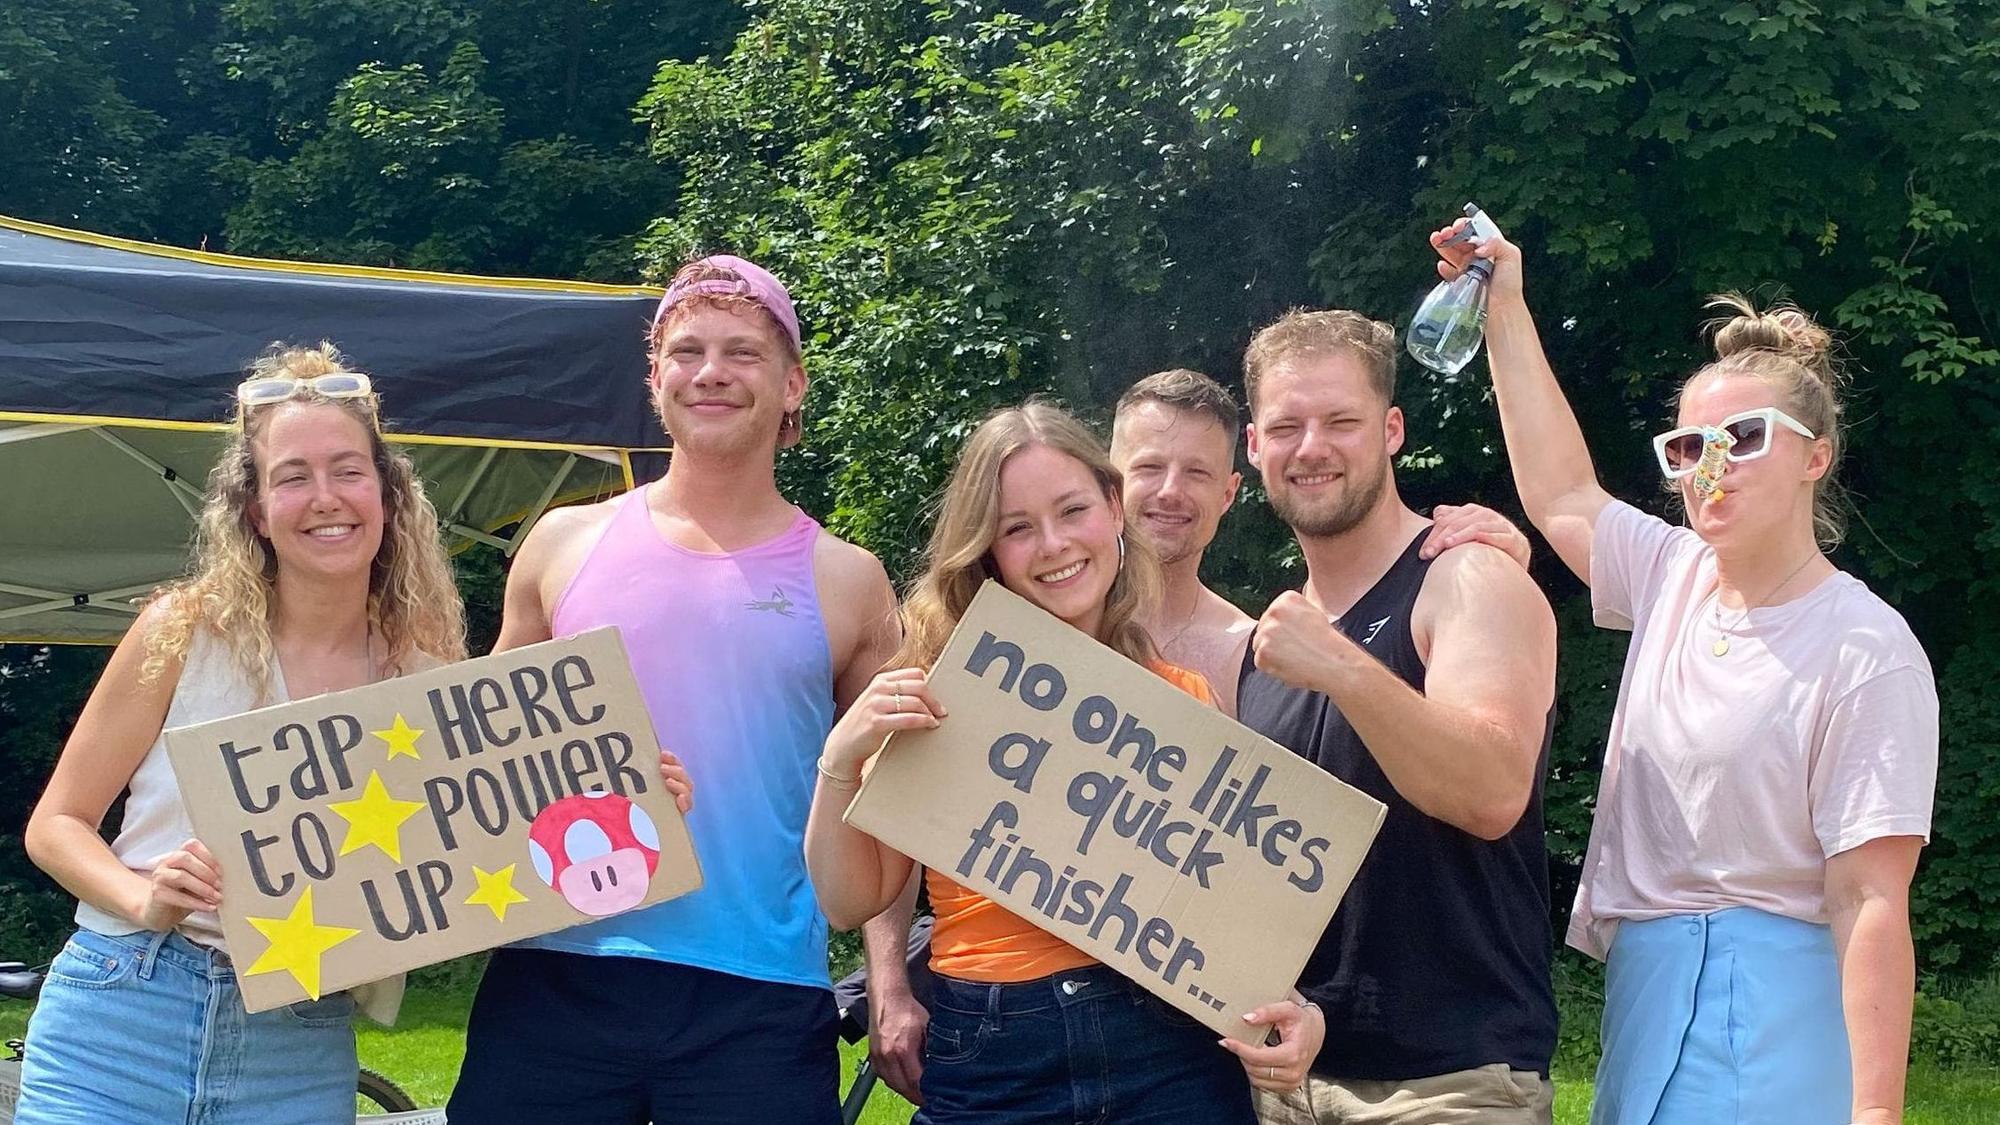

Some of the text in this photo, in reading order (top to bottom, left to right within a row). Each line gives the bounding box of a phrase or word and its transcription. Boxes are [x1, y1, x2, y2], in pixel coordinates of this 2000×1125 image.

[963, 630, 1331, 893] no one likes
[988, 732, 1225, 890] a quick
[241, 811, 335, 898] to
[955, 800, 1227, 1013] finisher...
